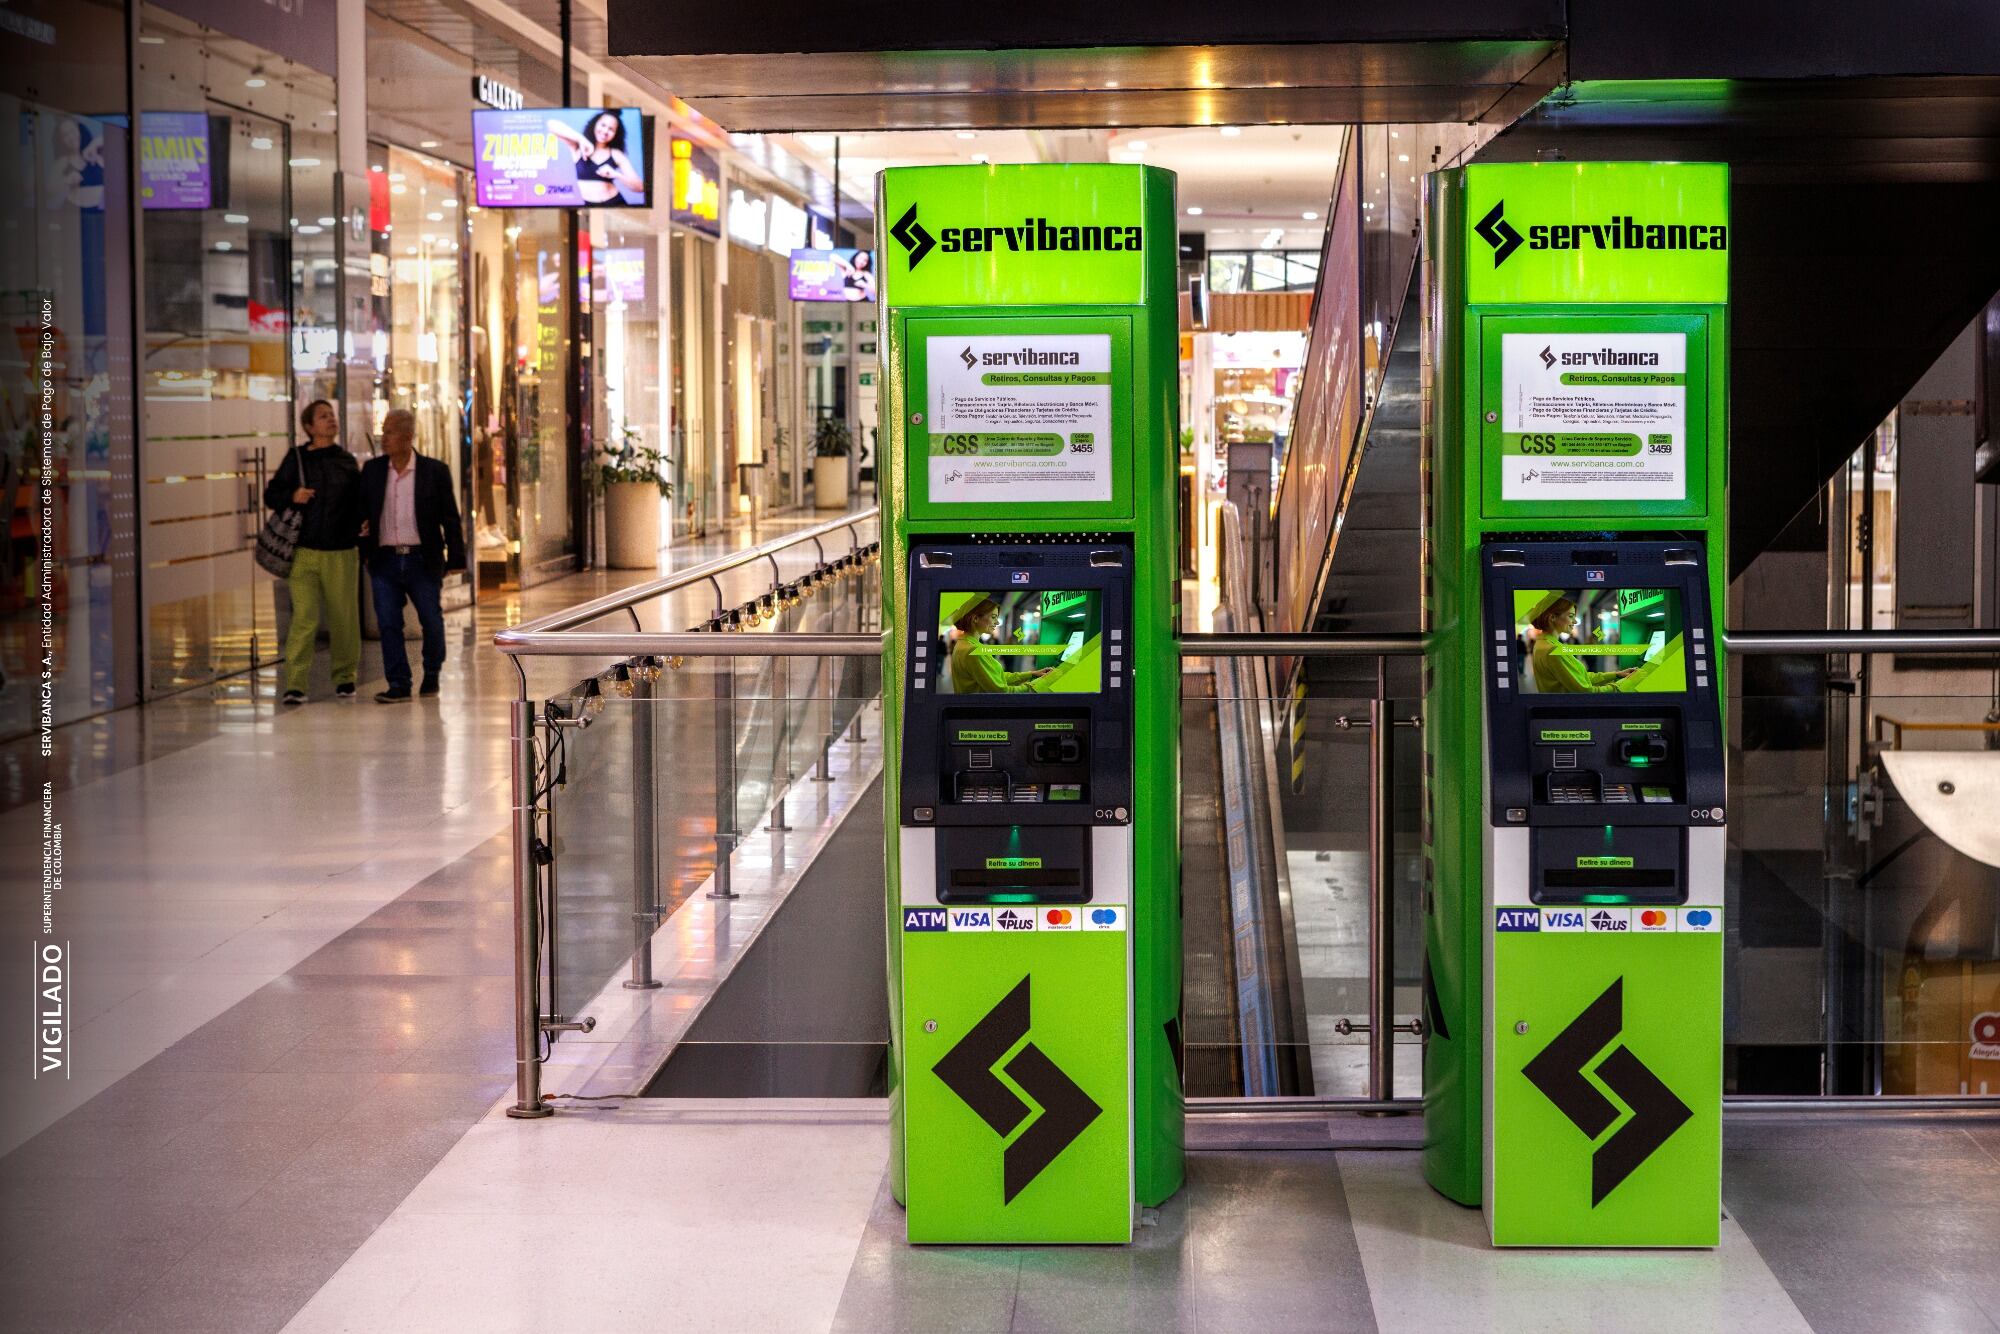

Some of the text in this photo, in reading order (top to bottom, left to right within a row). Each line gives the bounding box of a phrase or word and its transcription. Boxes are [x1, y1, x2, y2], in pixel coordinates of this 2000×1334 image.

[482, 133, 559, 161] ZUMBA
[941, 218, 1142, 252] servibanca
[1529, 216, 1727, 250] servibanca
[982, 348, 1080, 366] servibanca
[1561, 348, 1659, 366] servibanca
[990, 374, 1021, 382] Retiros,
[1064, 376, 1070, 384] y
[1071, 374, 1096, 384] Pagos
[1569, 374, 1676, 384] Retiros, Consultas y Pagos
[943, 434, 979, 454] CSS
[1070, 444, 1093, 452] 3455
[1520, 434, 1556, 454] CSS
[1650, 444, 1672, 453] 3459
[905, 912, 1033, 930] ATM VISA PLUS
[1498, 912, 1628, 931] ATM VISA PLUS
